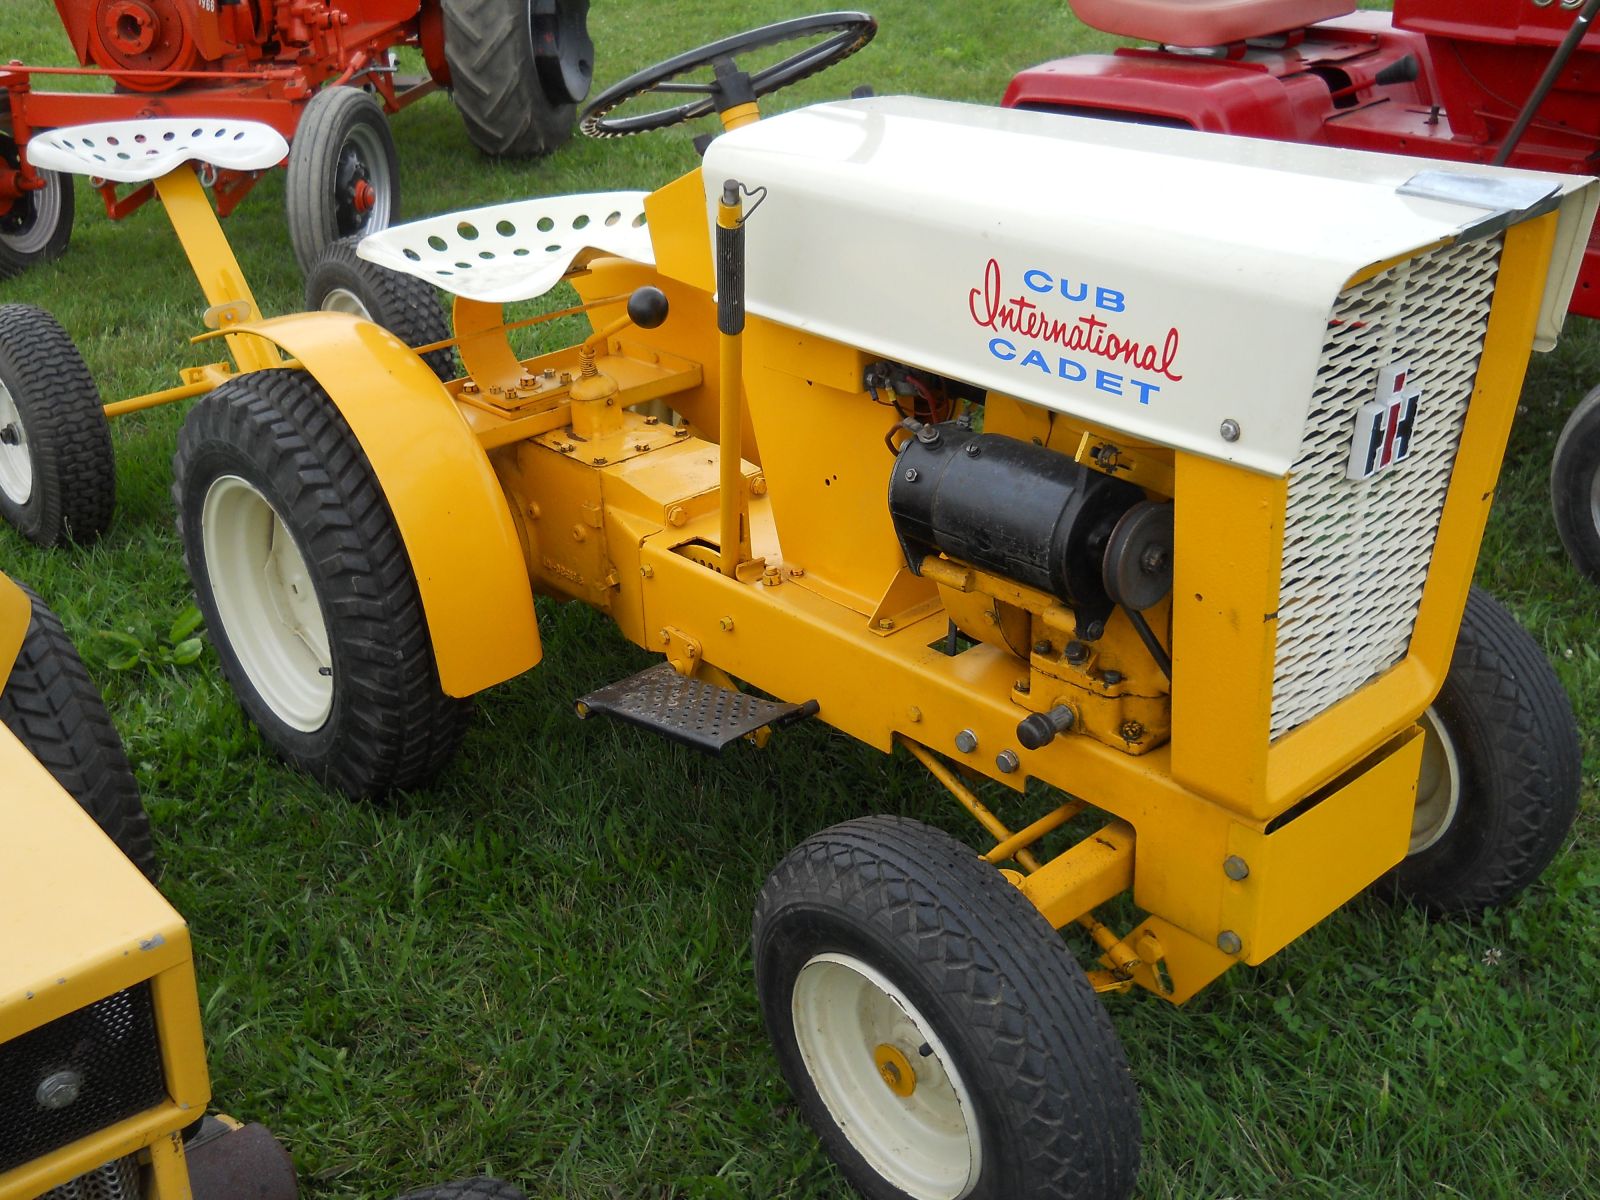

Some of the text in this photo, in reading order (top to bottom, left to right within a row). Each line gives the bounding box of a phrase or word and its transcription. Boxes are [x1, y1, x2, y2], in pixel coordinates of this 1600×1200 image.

[969, 258, 1183, 382] International
[1023, 269, 1126, 313] CUB
[988, 338, 1161, 405] CADET
